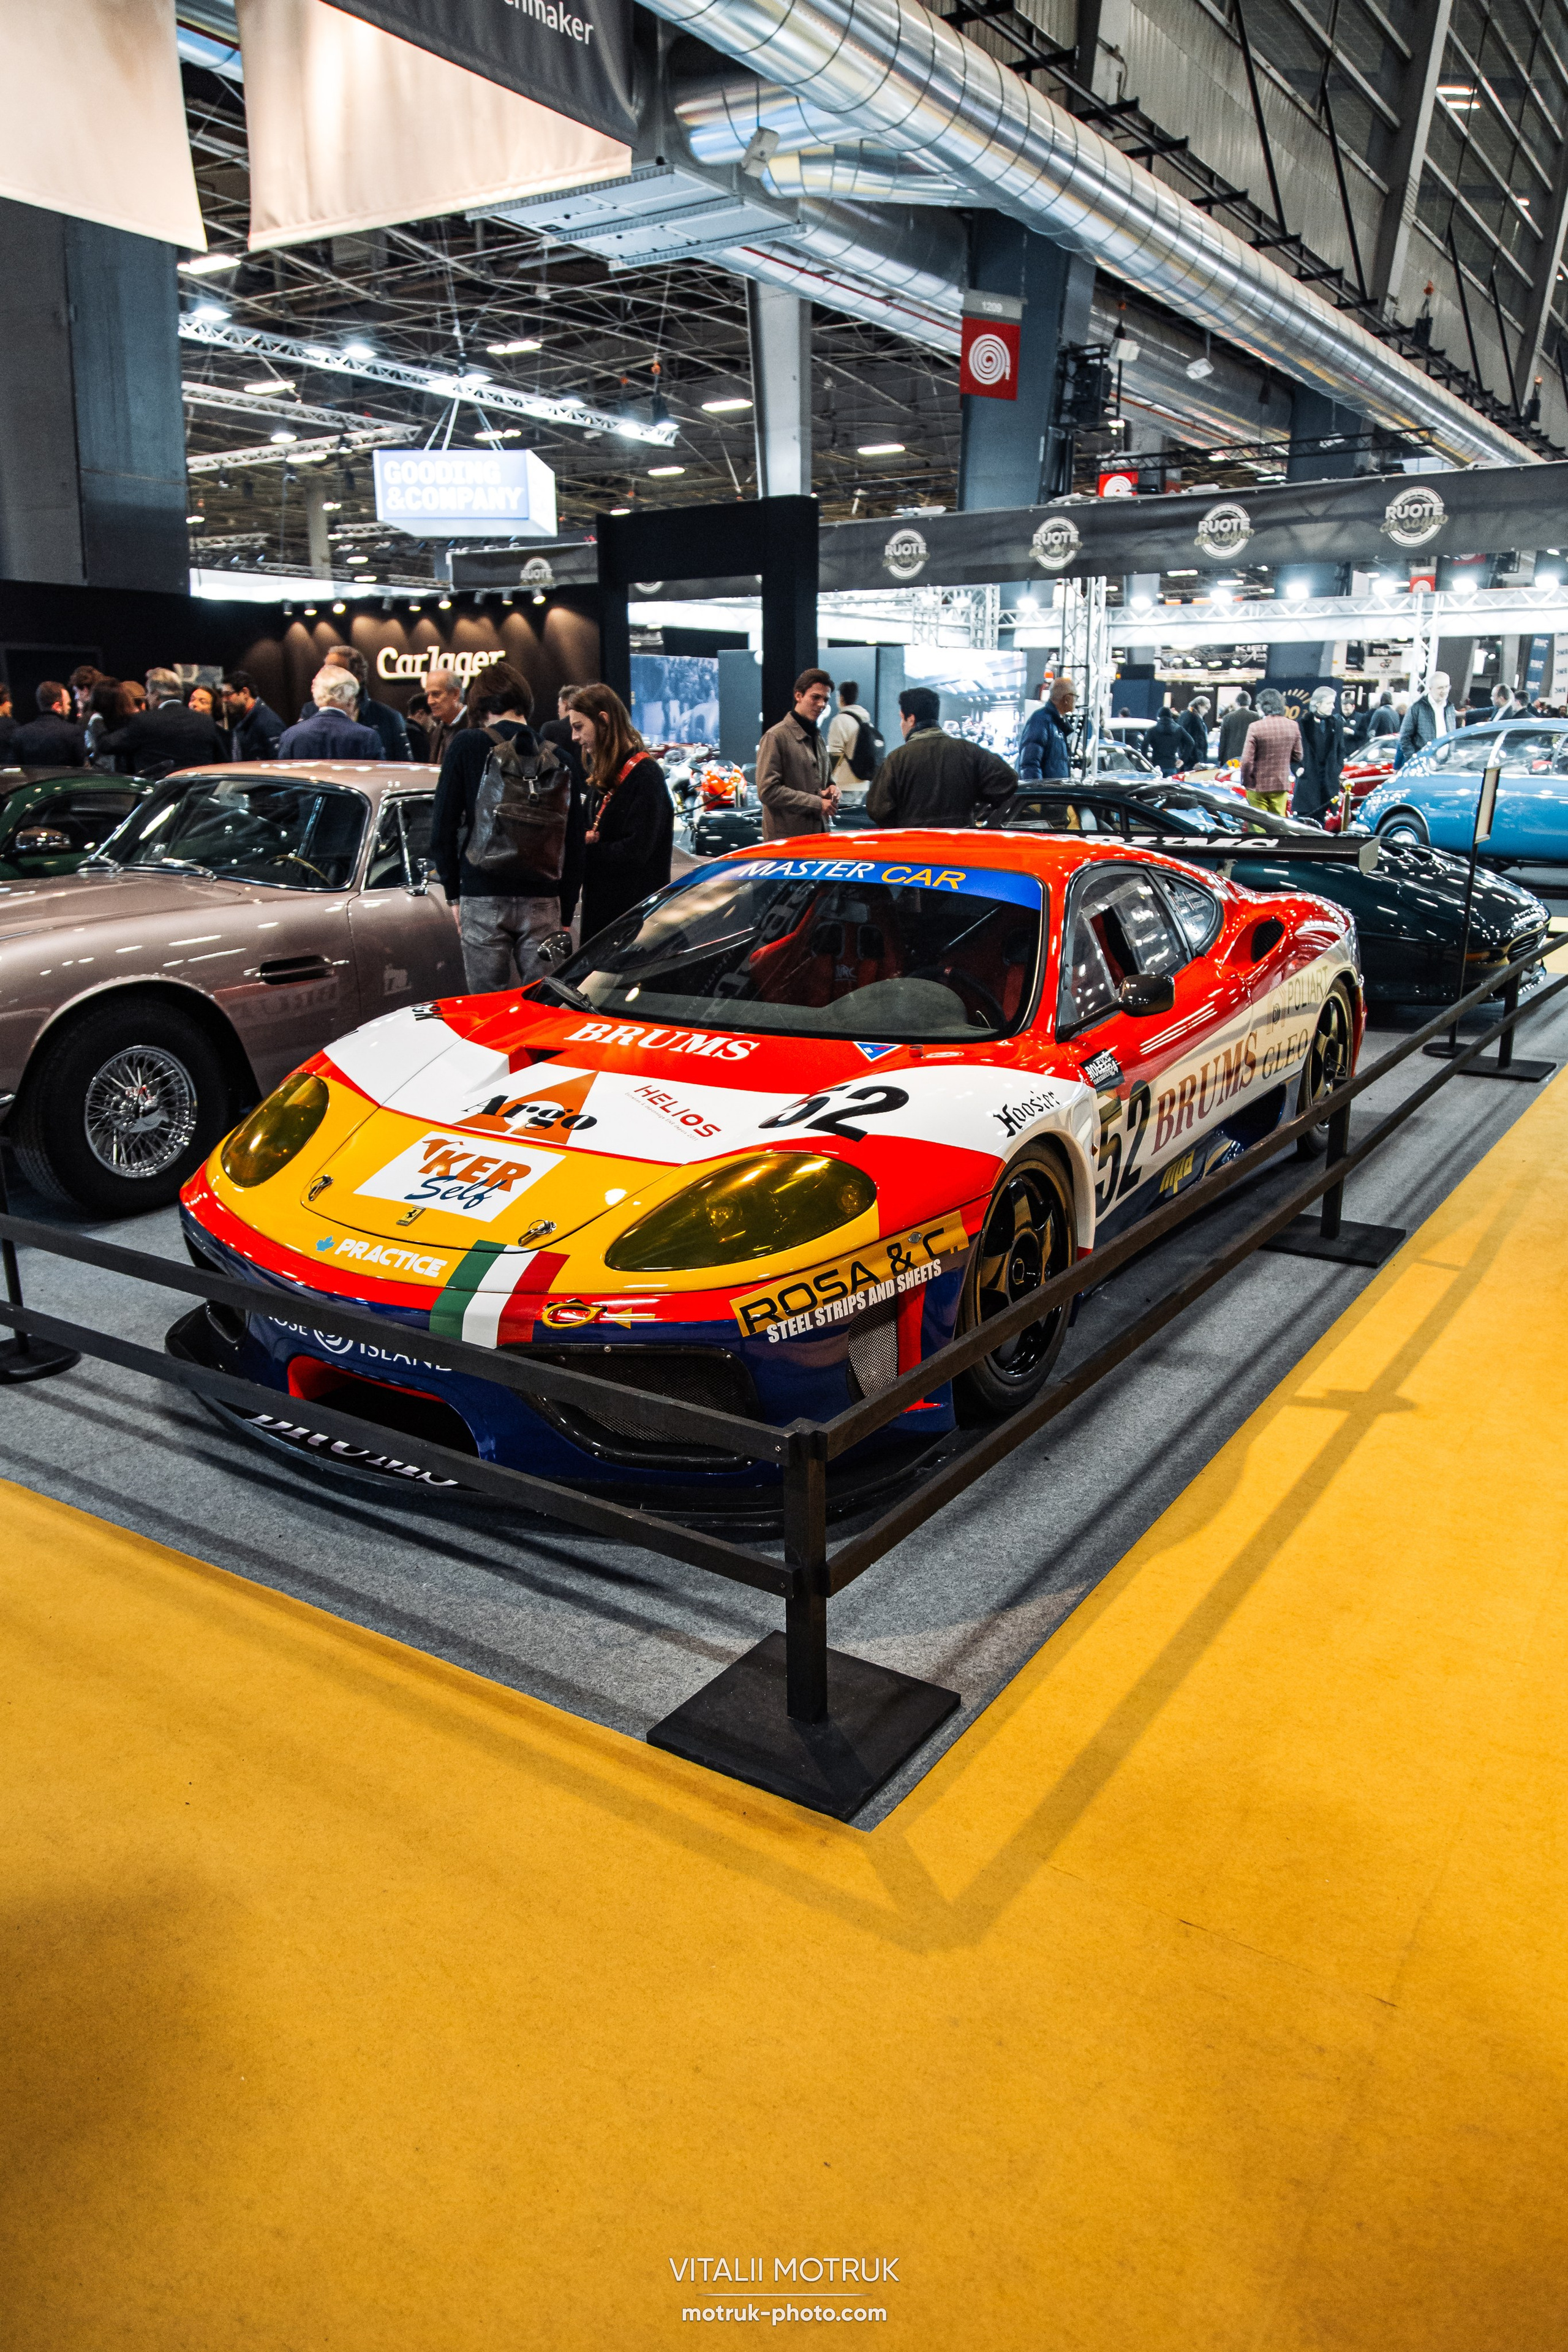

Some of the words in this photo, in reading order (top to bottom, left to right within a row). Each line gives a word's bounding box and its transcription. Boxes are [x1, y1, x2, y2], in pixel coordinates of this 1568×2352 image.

[383, 460, 501, 485] GOODING
[386, 486, 523, 511] &COMPANY
[1385, 502, 1444, 519] RUOTE
[1033, 530, 1079, 546] RUOTE
[1197, 518, 1250, 533] RUOTE
[884, 542, 927, 556] RUOTE
[738, 861, 875, 878] MASTER
[881, 865, 967, 889] CAR
[564, 1022, 761, 1060] BRUMS
[1262, 1028, 1308, 1080] GLEO
[461, 1094, 598, 1131] Argo
[633, 1085, 722, 1137] HELIOS
[1151, 1031, 1258, 1156] BRUMS
[758, 1084, 910, 1143] 52
[993, 1090, 1061, 1138] Hoosier
[1095, 1080, 1151, 1219] 52
[404, 1175, 508, 1210] Self
[334, 1238, 448, 1278] PRACTICE
[739, 1261, 881, 1334] ROSA
[886, 1242, 914, 1277] &
[766, 1310, 813, 1343] STEEL
[815, 1292, 867, 1327] STRIPS
[868, 1277, 897, 1306] AND
[896, 1259, 943, 1291] SHEETS
